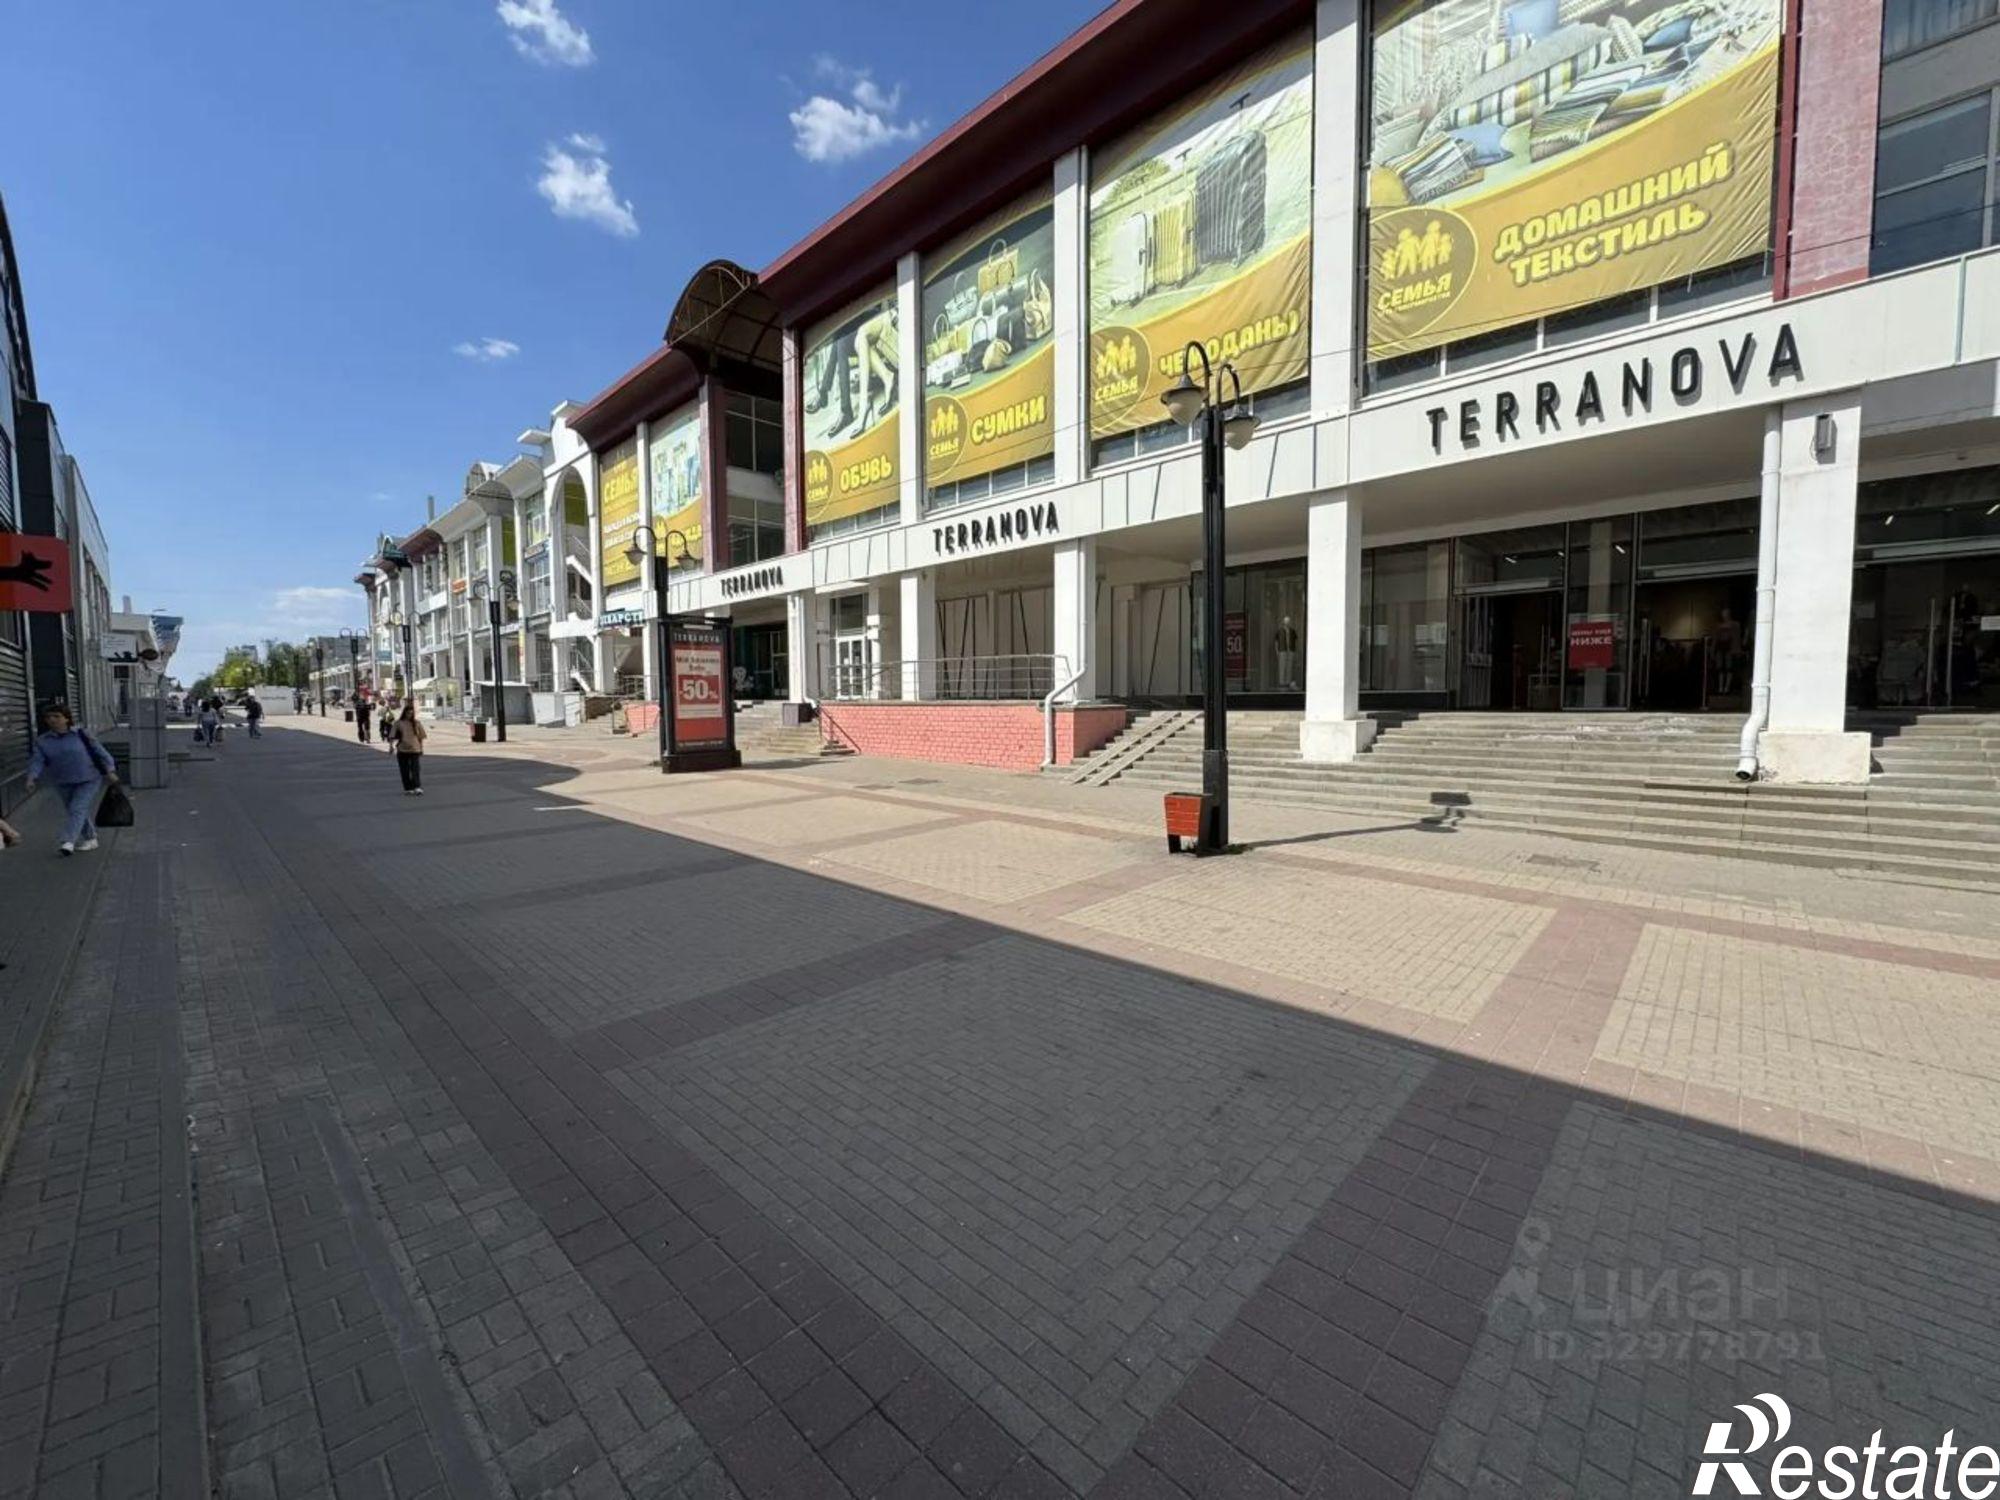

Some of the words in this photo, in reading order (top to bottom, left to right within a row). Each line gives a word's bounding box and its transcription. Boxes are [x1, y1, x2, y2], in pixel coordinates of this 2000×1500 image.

[1494, 143, 1733, 261] ДОМАШНИЙ
[1510, 204, 1709, 284] ТЕКСТИЛЬ
[1378, 272, 1452, 309] СЕМЬЯ
[1095, 375, 1138, 399] СЕМЬЯ
[1426, 323, 1802, 451] TERRANOVA
[971, 396, 1047, 445] СУМКИ
[930, 438, 959, 456] СЕМЬЯ
[839, 455, 892, 492] ОБУВЬ
[933, 502, 1058, 554] TERRANOVA
[720, 566, 783, 597] TERRANOVA
